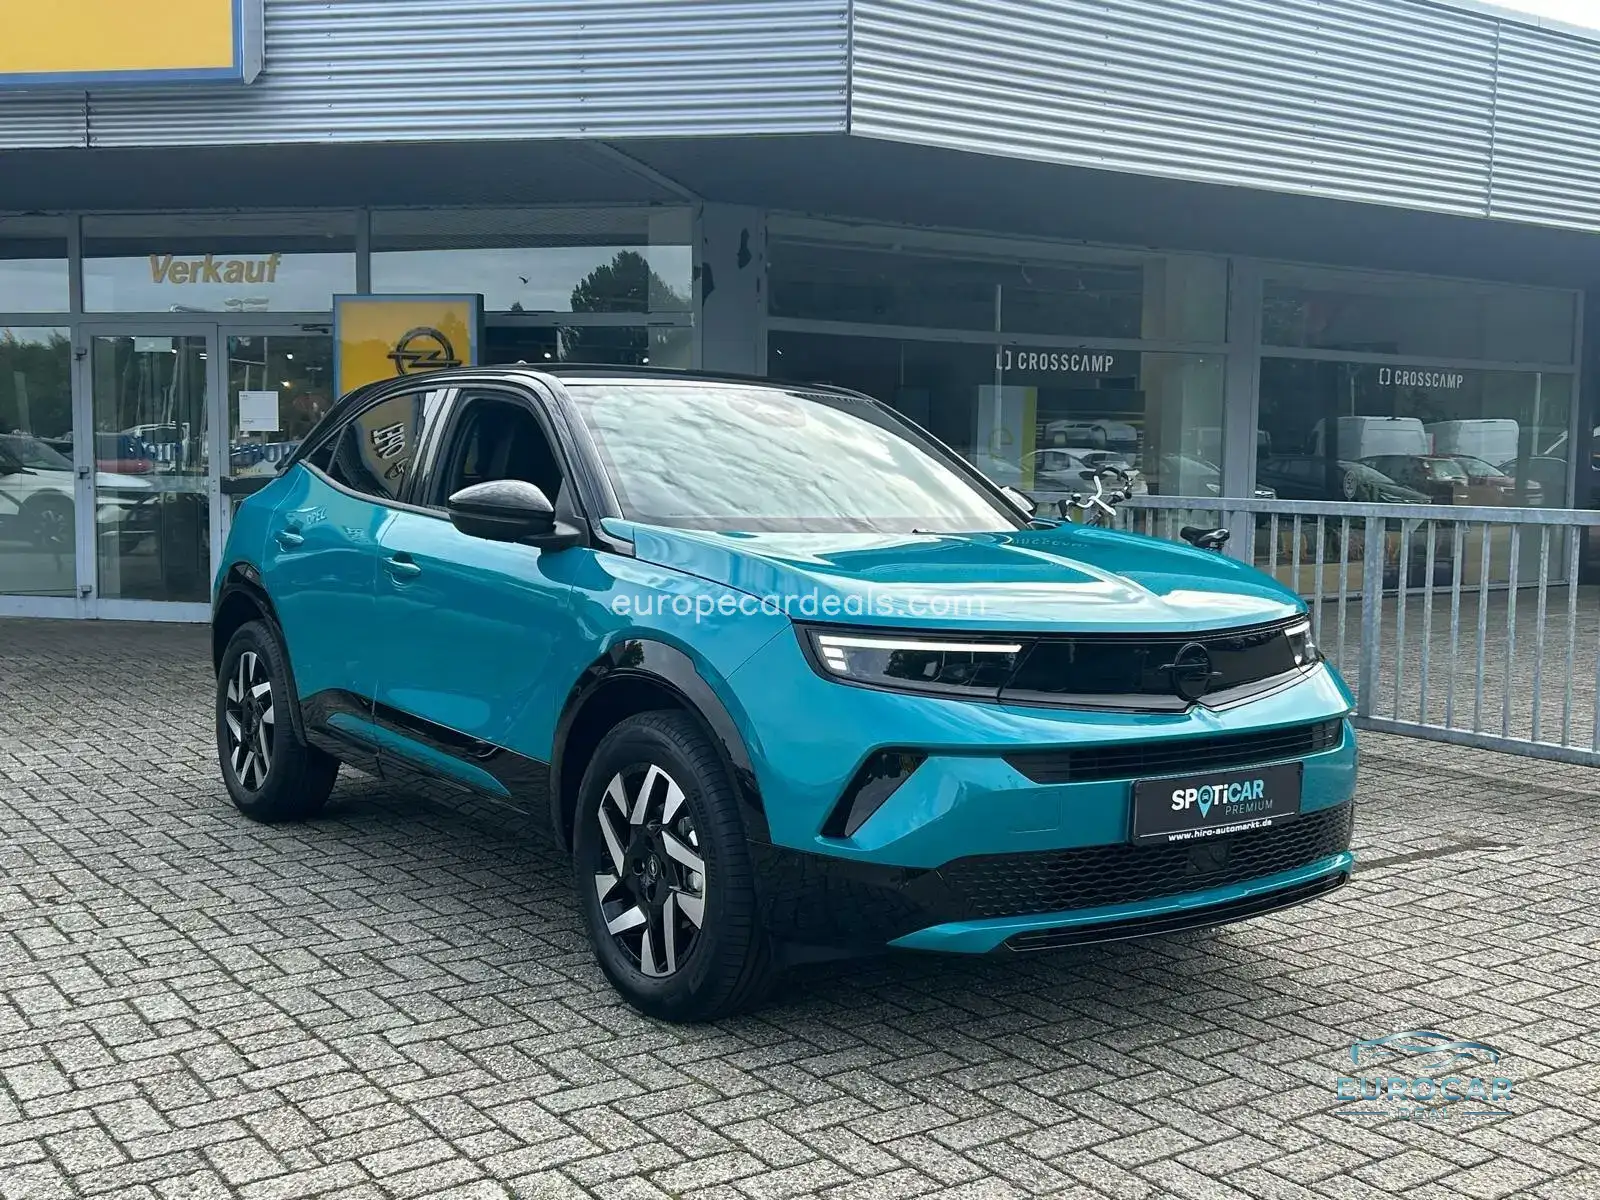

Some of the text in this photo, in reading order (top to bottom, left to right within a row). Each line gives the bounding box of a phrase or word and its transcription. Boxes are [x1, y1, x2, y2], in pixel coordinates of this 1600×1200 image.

[149, 252, 282, 284] Verkauf
[1018, 351, 1114, 372] CROSSCAMP
[1395, 369, 1464, 389] CROSSCAMP
[1225, 799, 1273, 816] PREMIUM
[1168, 818, 1273, 842] www.hiro-automarkt.de
